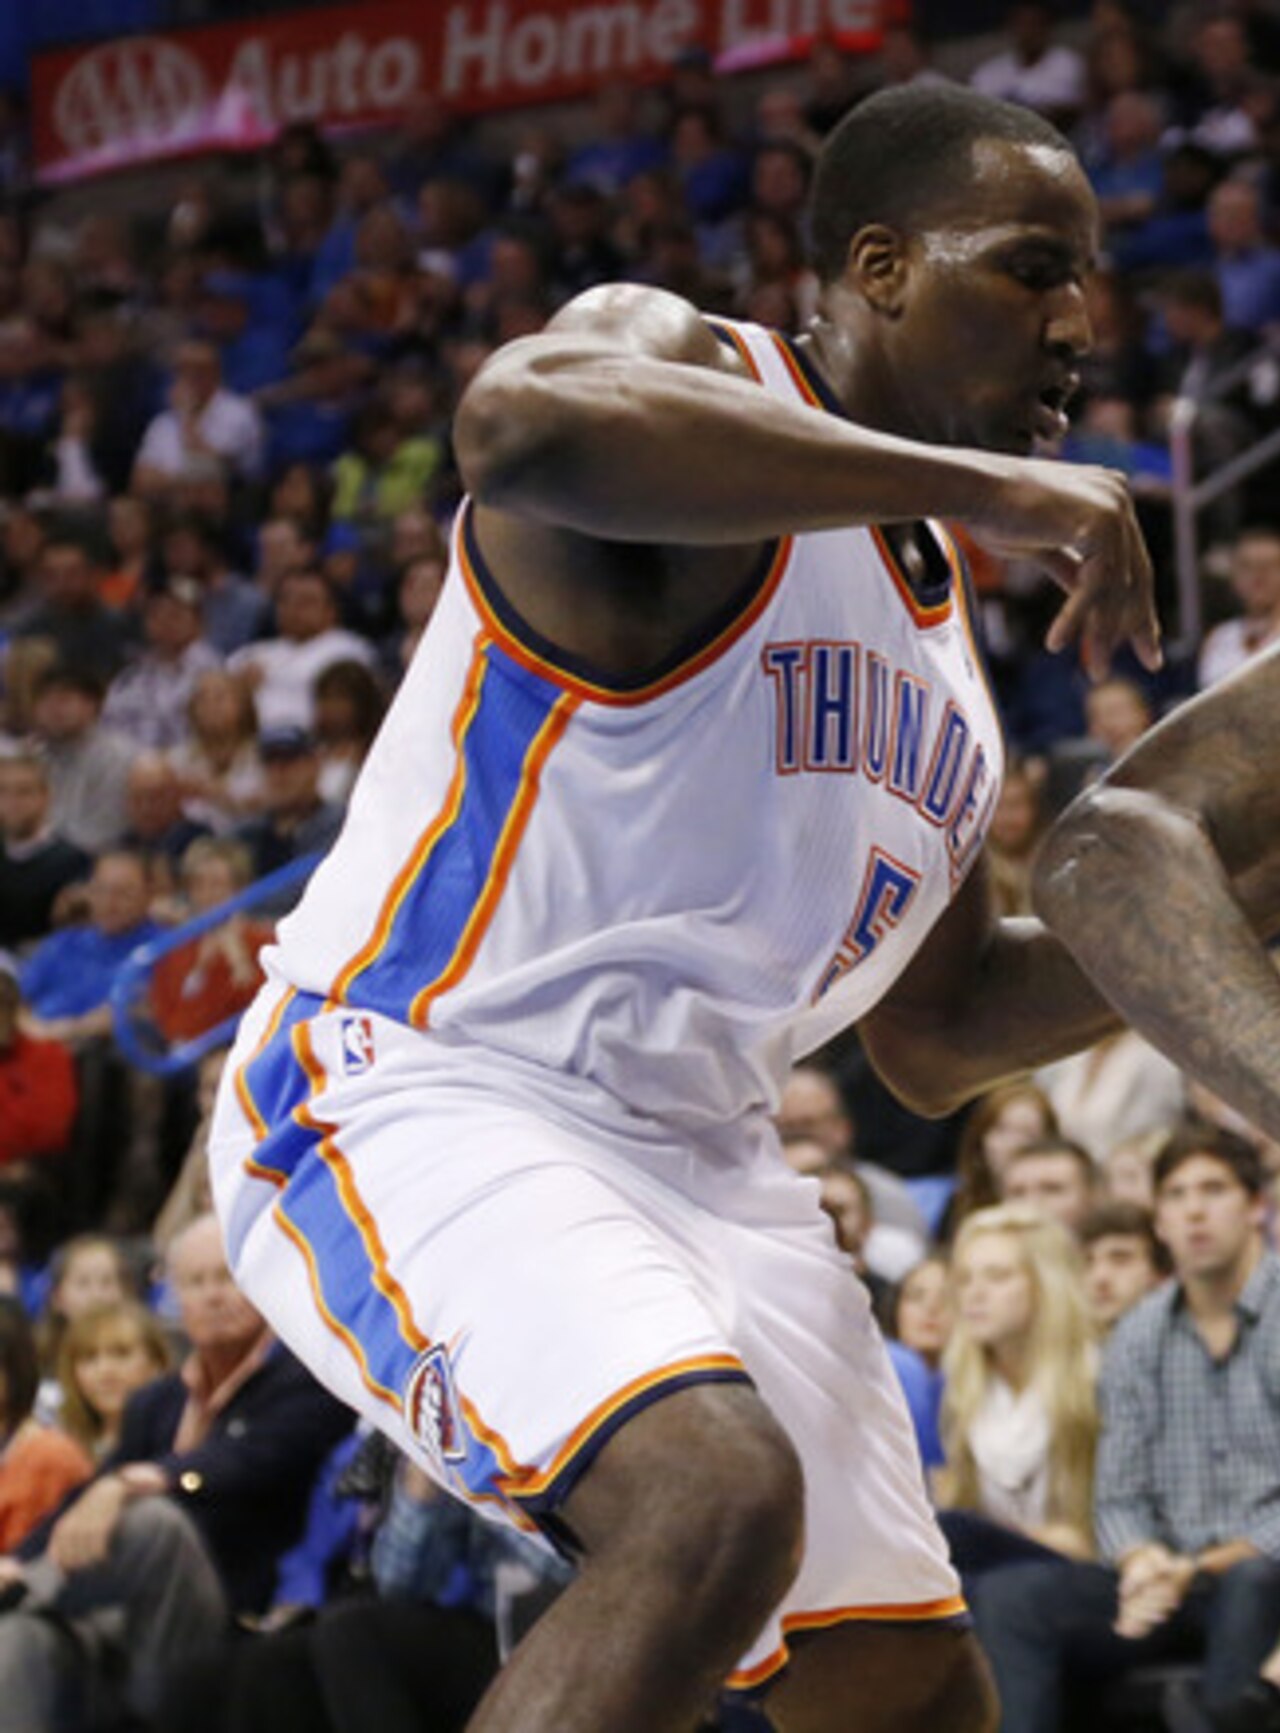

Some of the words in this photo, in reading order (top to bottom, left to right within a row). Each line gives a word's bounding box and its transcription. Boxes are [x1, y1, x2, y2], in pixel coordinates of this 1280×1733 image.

[214, 34, 421, 130] Auto
[442, 3, 698, 94] Home
[761, 639, 1001, 892] THUNDE
